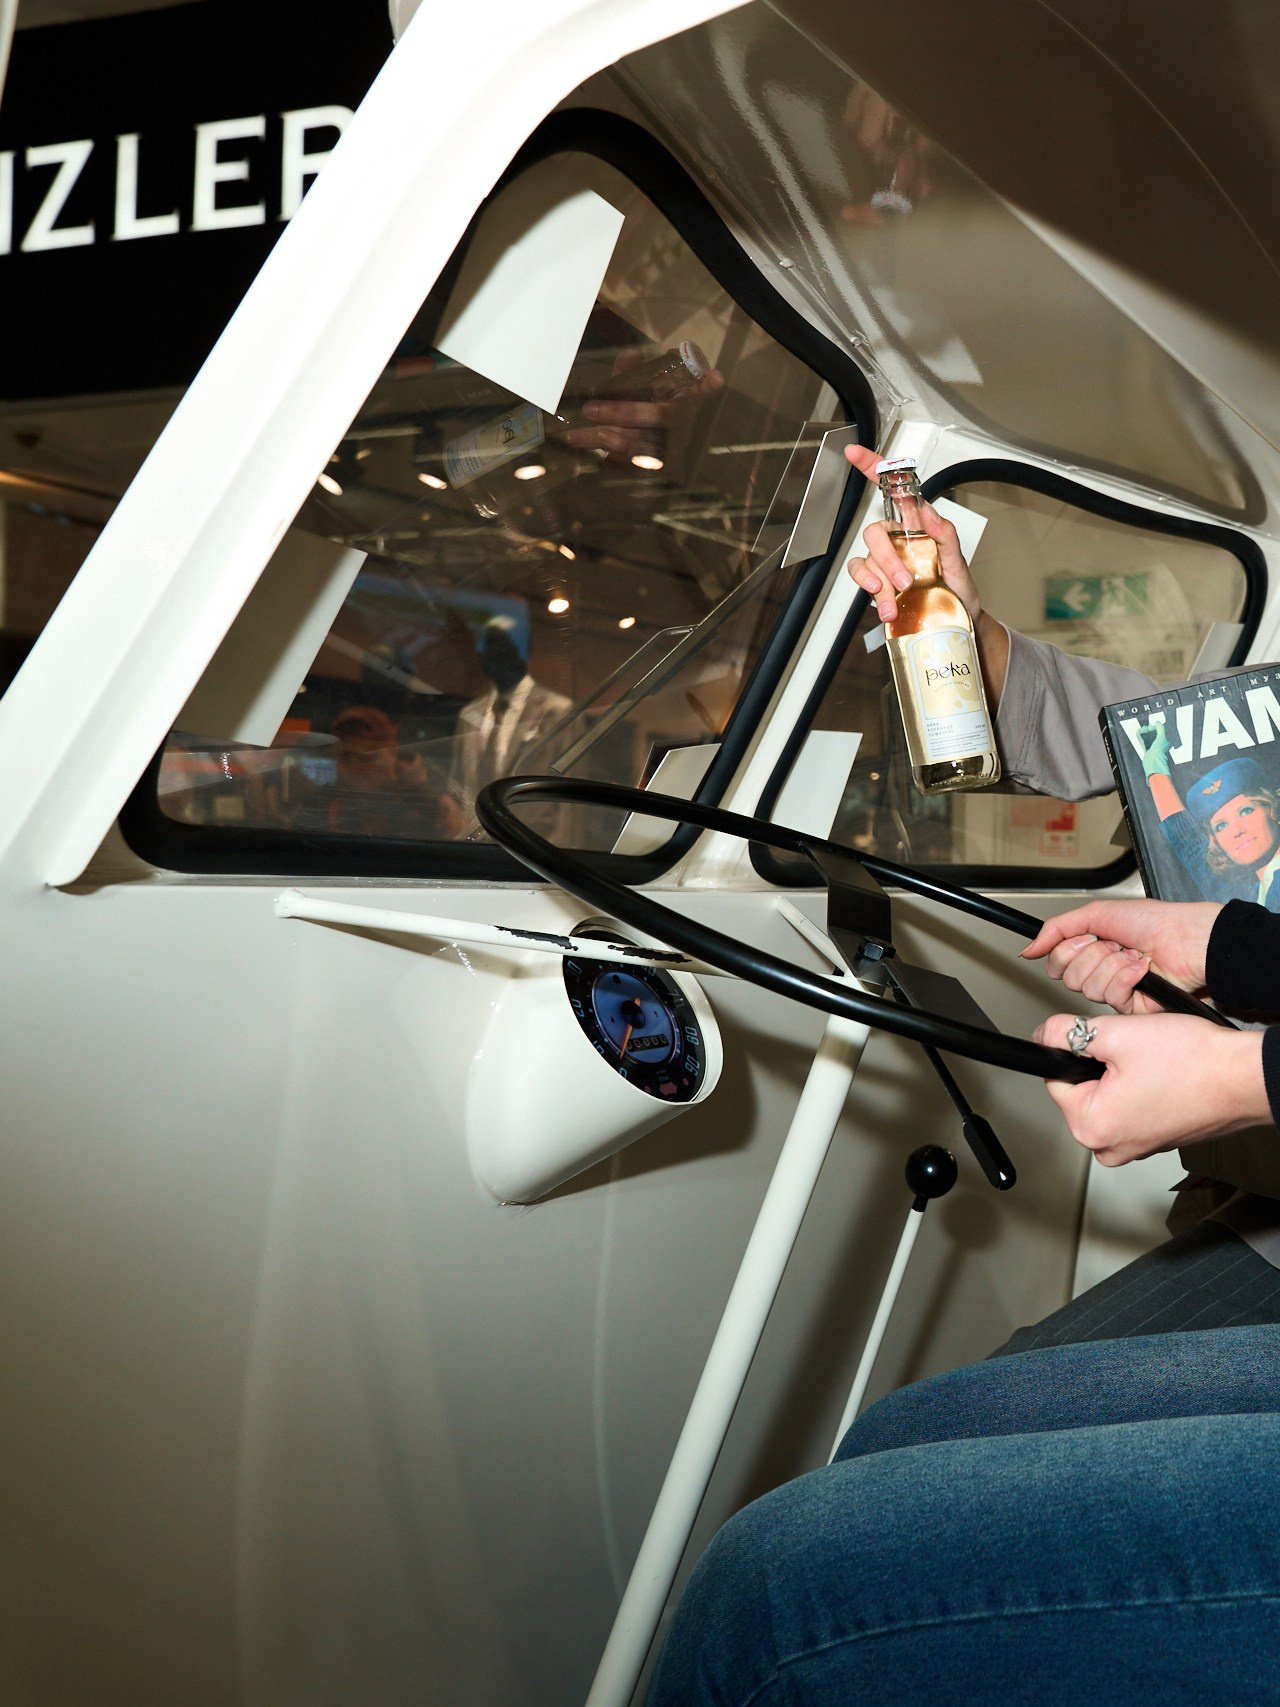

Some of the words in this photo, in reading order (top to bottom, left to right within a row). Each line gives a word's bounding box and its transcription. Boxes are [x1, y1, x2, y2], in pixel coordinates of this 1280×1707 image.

[925, 661, 971, 686] река
[1117, 699, 1175, 718] WORLD
[1197, 685, 1228, 699] ART
[685, 1026, 699, 1046] 80
[685, 1055, 700, 1076] 90
